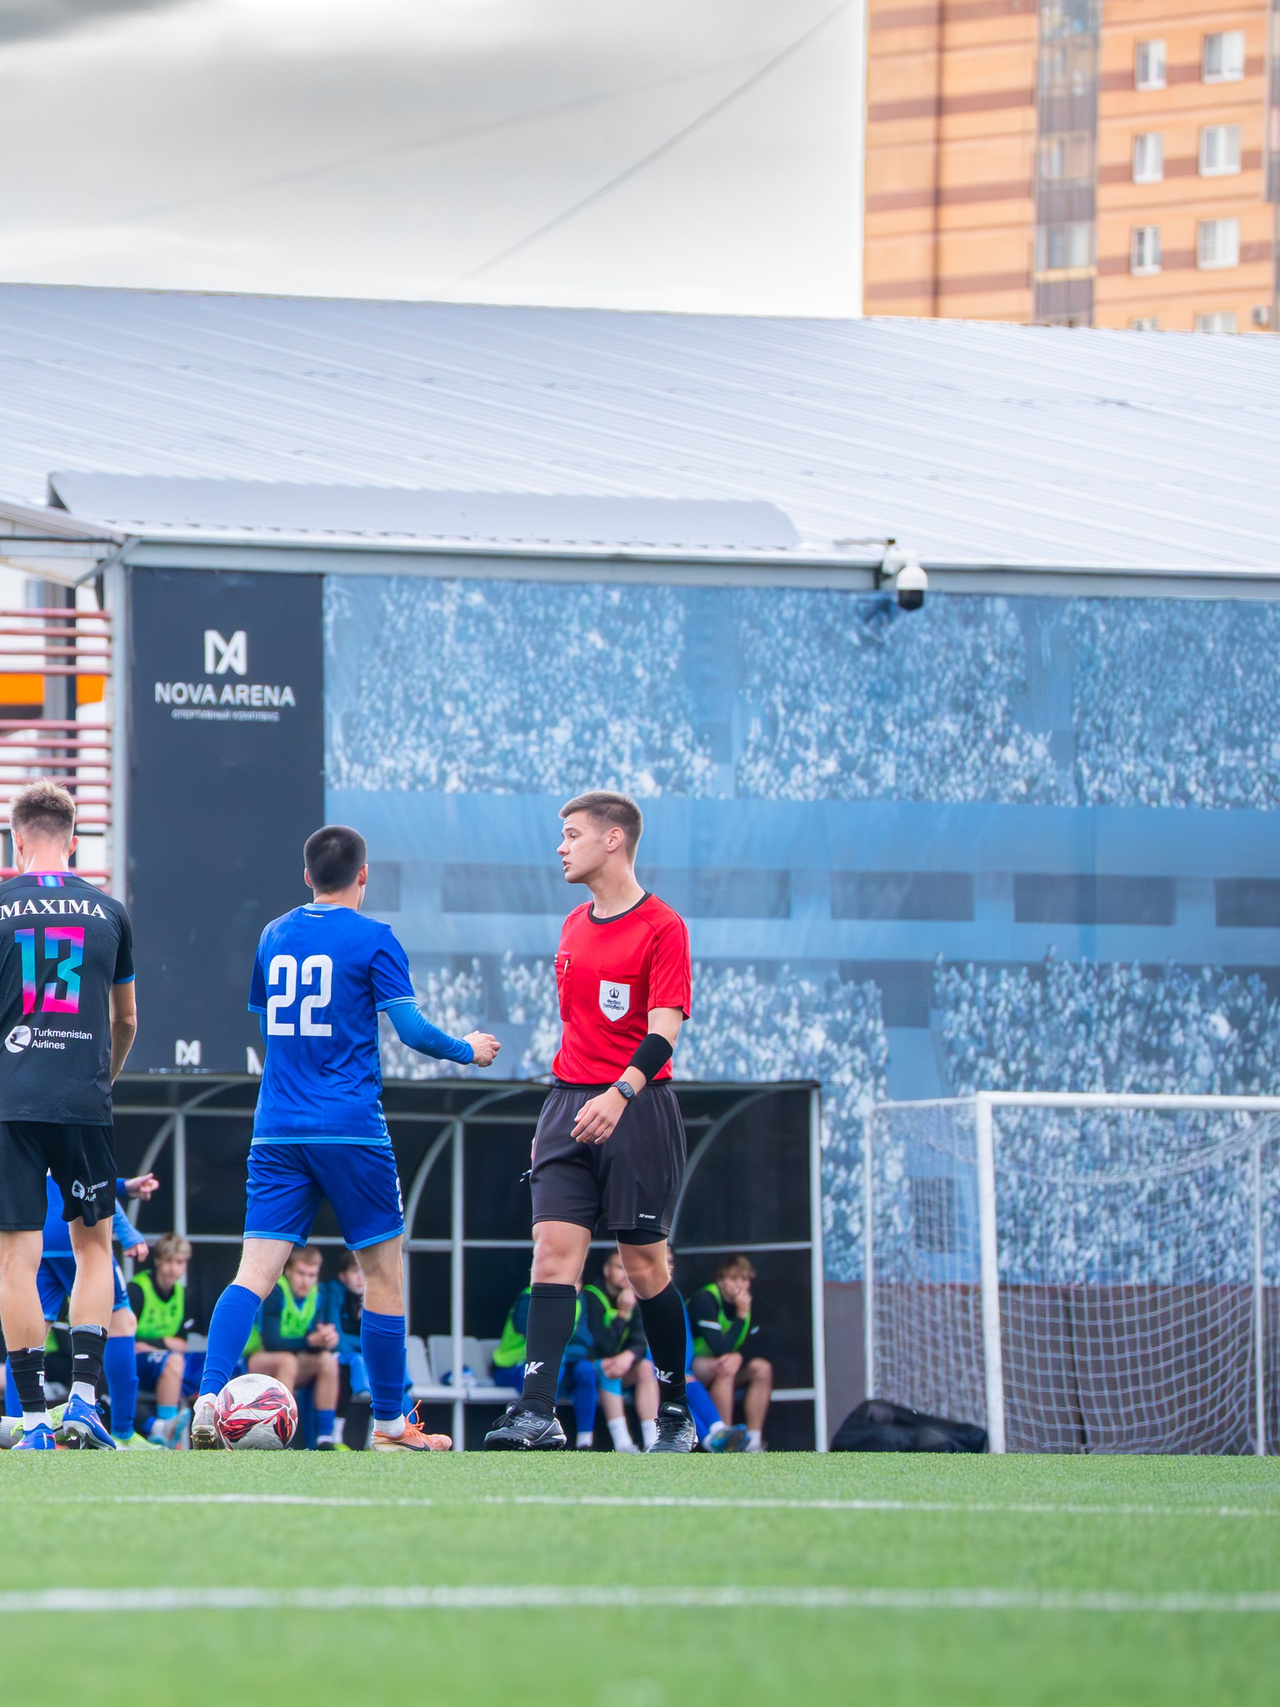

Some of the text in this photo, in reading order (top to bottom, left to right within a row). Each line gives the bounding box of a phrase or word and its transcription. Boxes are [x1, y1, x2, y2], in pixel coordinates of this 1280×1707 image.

[154, 681, 296, 707] NOVA ARENA
[0, 898, 107, 921] MAXIMA
[14, 926, 85, 1014] 13
[267, 954, 333, 1037] 22
[31, 1039, 66, 1050] Airlines
[33, 1027, 93, 1041] Turkmenistan
